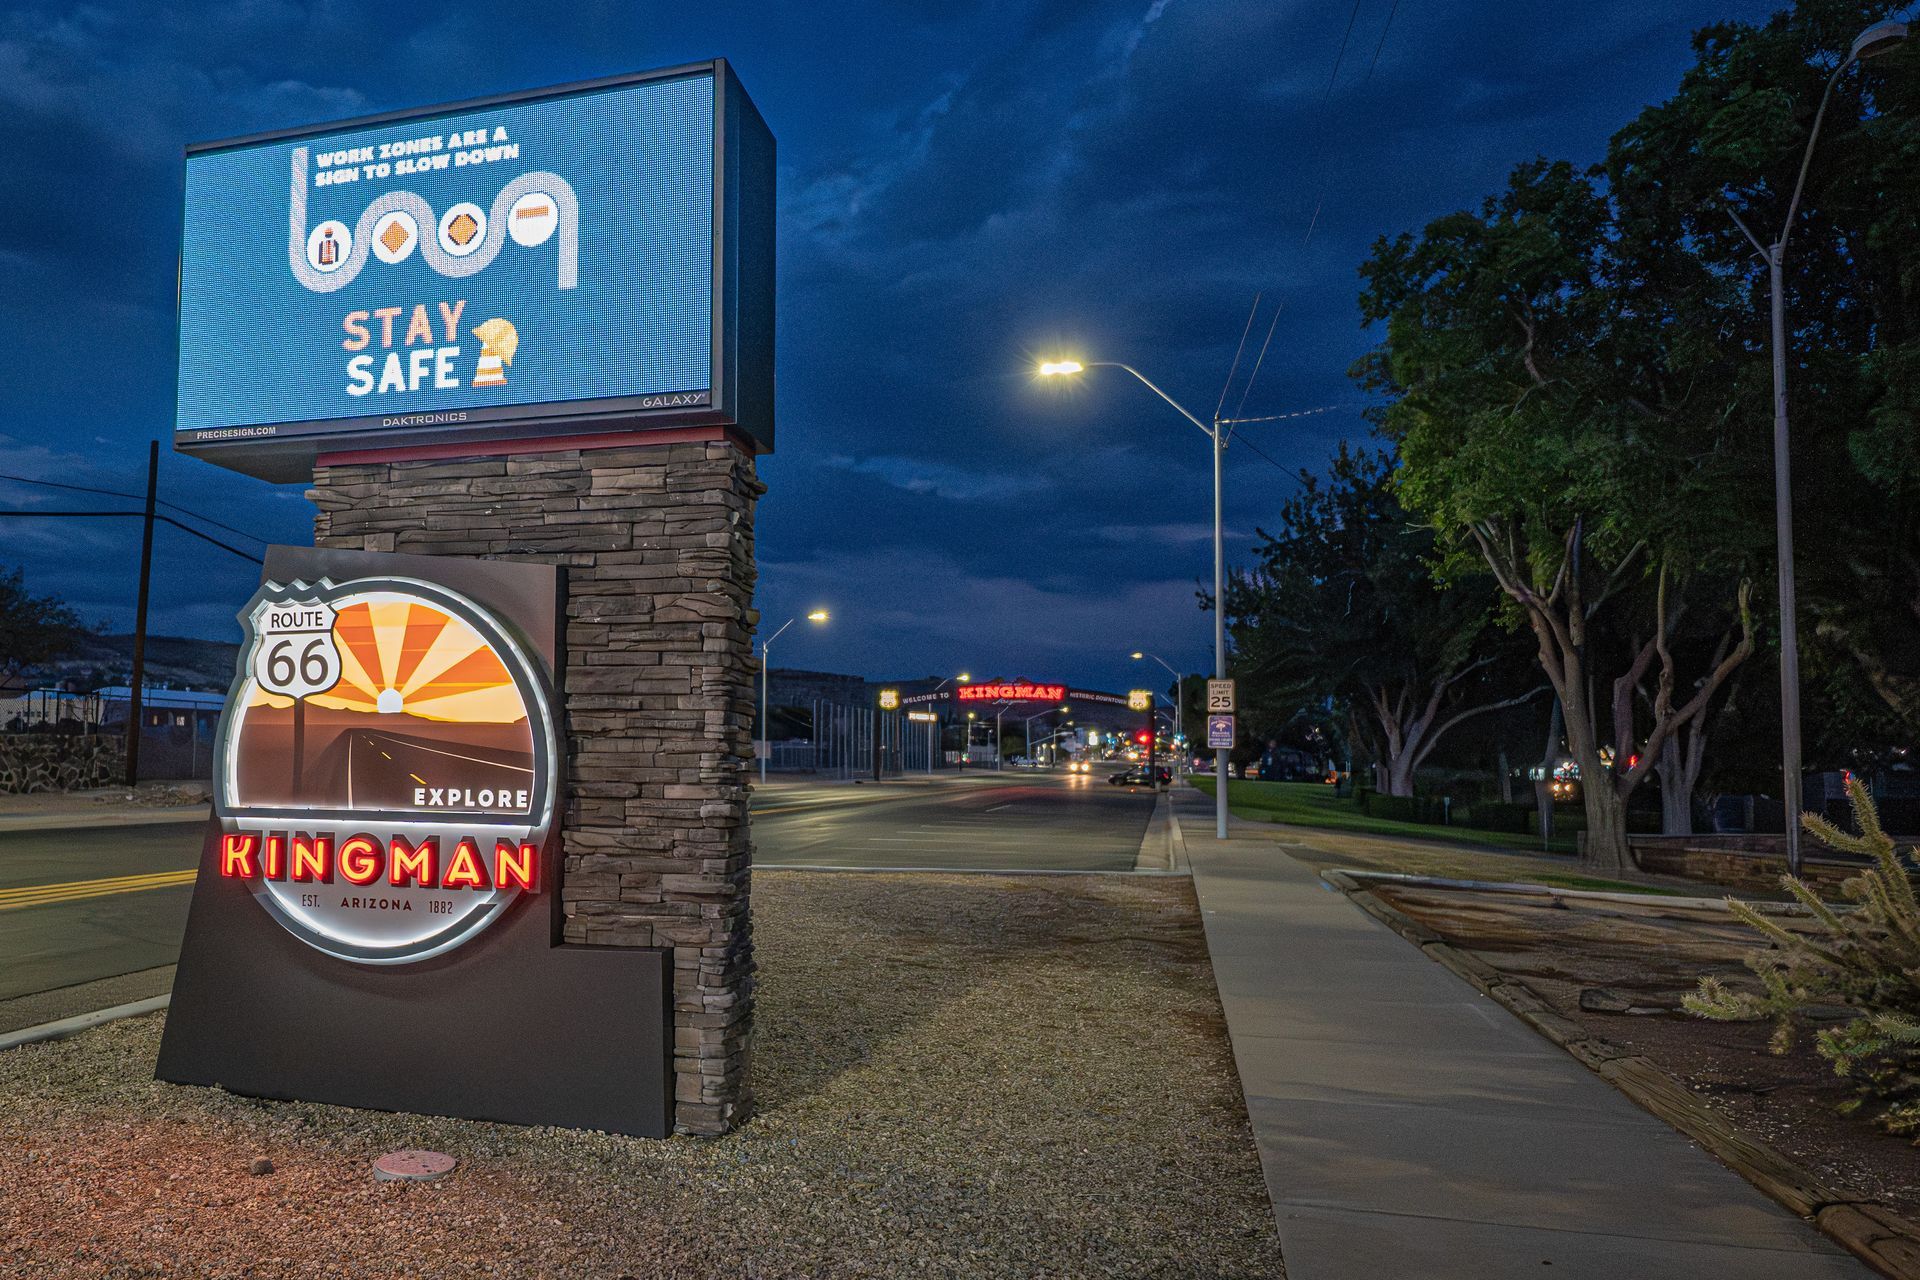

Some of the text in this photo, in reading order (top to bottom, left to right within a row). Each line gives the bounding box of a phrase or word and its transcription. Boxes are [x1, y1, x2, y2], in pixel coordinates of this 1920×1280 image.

[317, 126, 508, 168] WORK ZONES ARE A
[315, 144, 519, 187] SIGN TO SLOW DOWN
[342, 299, 467, 351] STAY
[346, 346, 460, 396] SAFE
[383, 412, 467, 427] DAKTRONICS
[197, 426, 276, 440] PRECISESIGN.COM
[270, 610, 324, 630] ROUTE
[266, 638, 330, 687] 66
[902, 693, 937, 704] WELCOME
[959, 686, 1064, 700] KINGMAN
[1211, 696, 1231, 708] 25
[413, 788, 529, 808] EXPLORE
[220, 834, 539, 891] KINGMAN
[301, 893, 453, 915] EST. ARIZONA 1882
